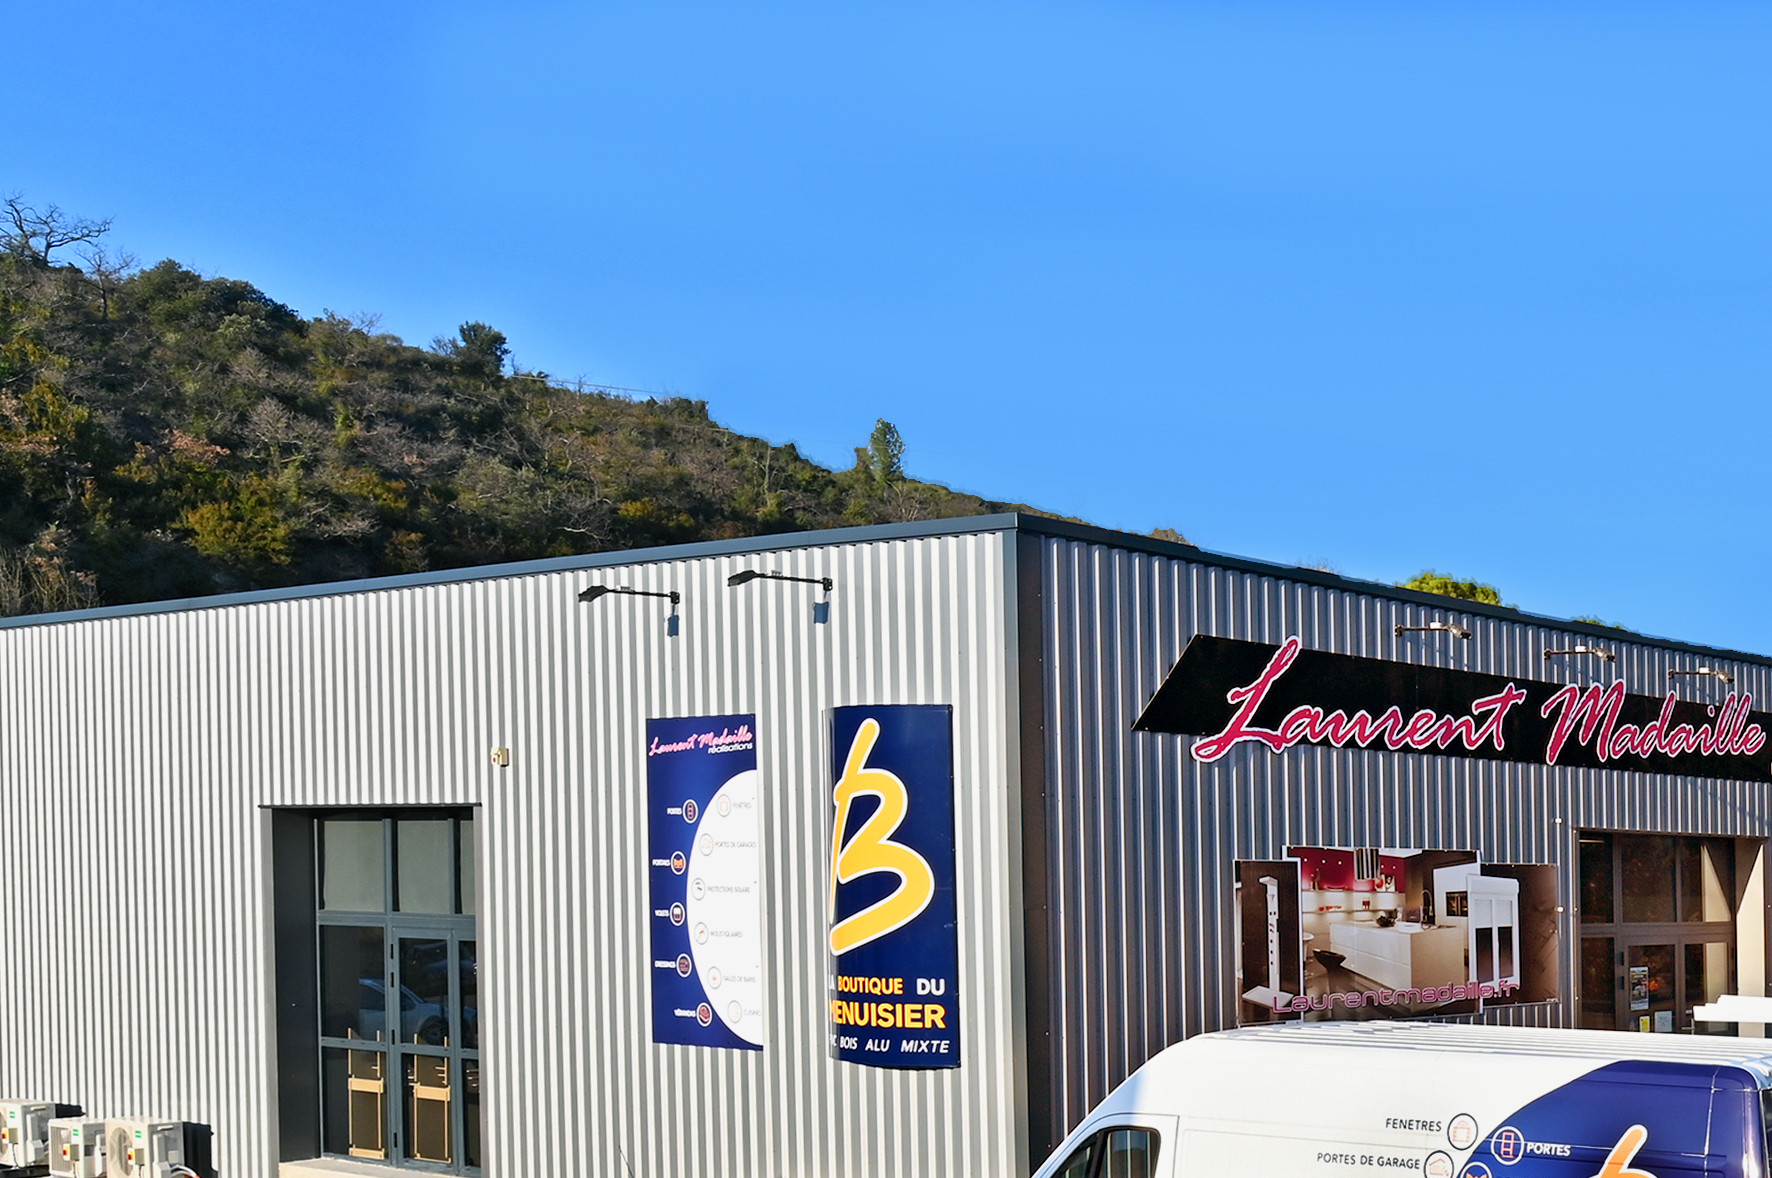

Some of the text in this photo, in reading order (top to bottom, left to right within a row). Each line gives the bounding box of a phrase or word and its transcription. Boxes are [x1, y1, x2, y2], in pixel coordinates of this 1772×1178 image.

[1191, 635, 1766, 766] Laurent Madaille
[838, 976, 945, 996] BOUTIQUE DU
[1273, 979, 1520, 1014] Laurentmadaille.fr
[840, 1036, 858, 1050] BOIS
[865, 1039, 891, 1052] ALU
[901, 1040, 951, 1054] MIXTE
[1386, 1118, 1442, 1132] FENETRES
[1526, 1142, 1571, 1157] PORTES
[1317, 1152, 1420, 1170] PORTES DE GARAGE
